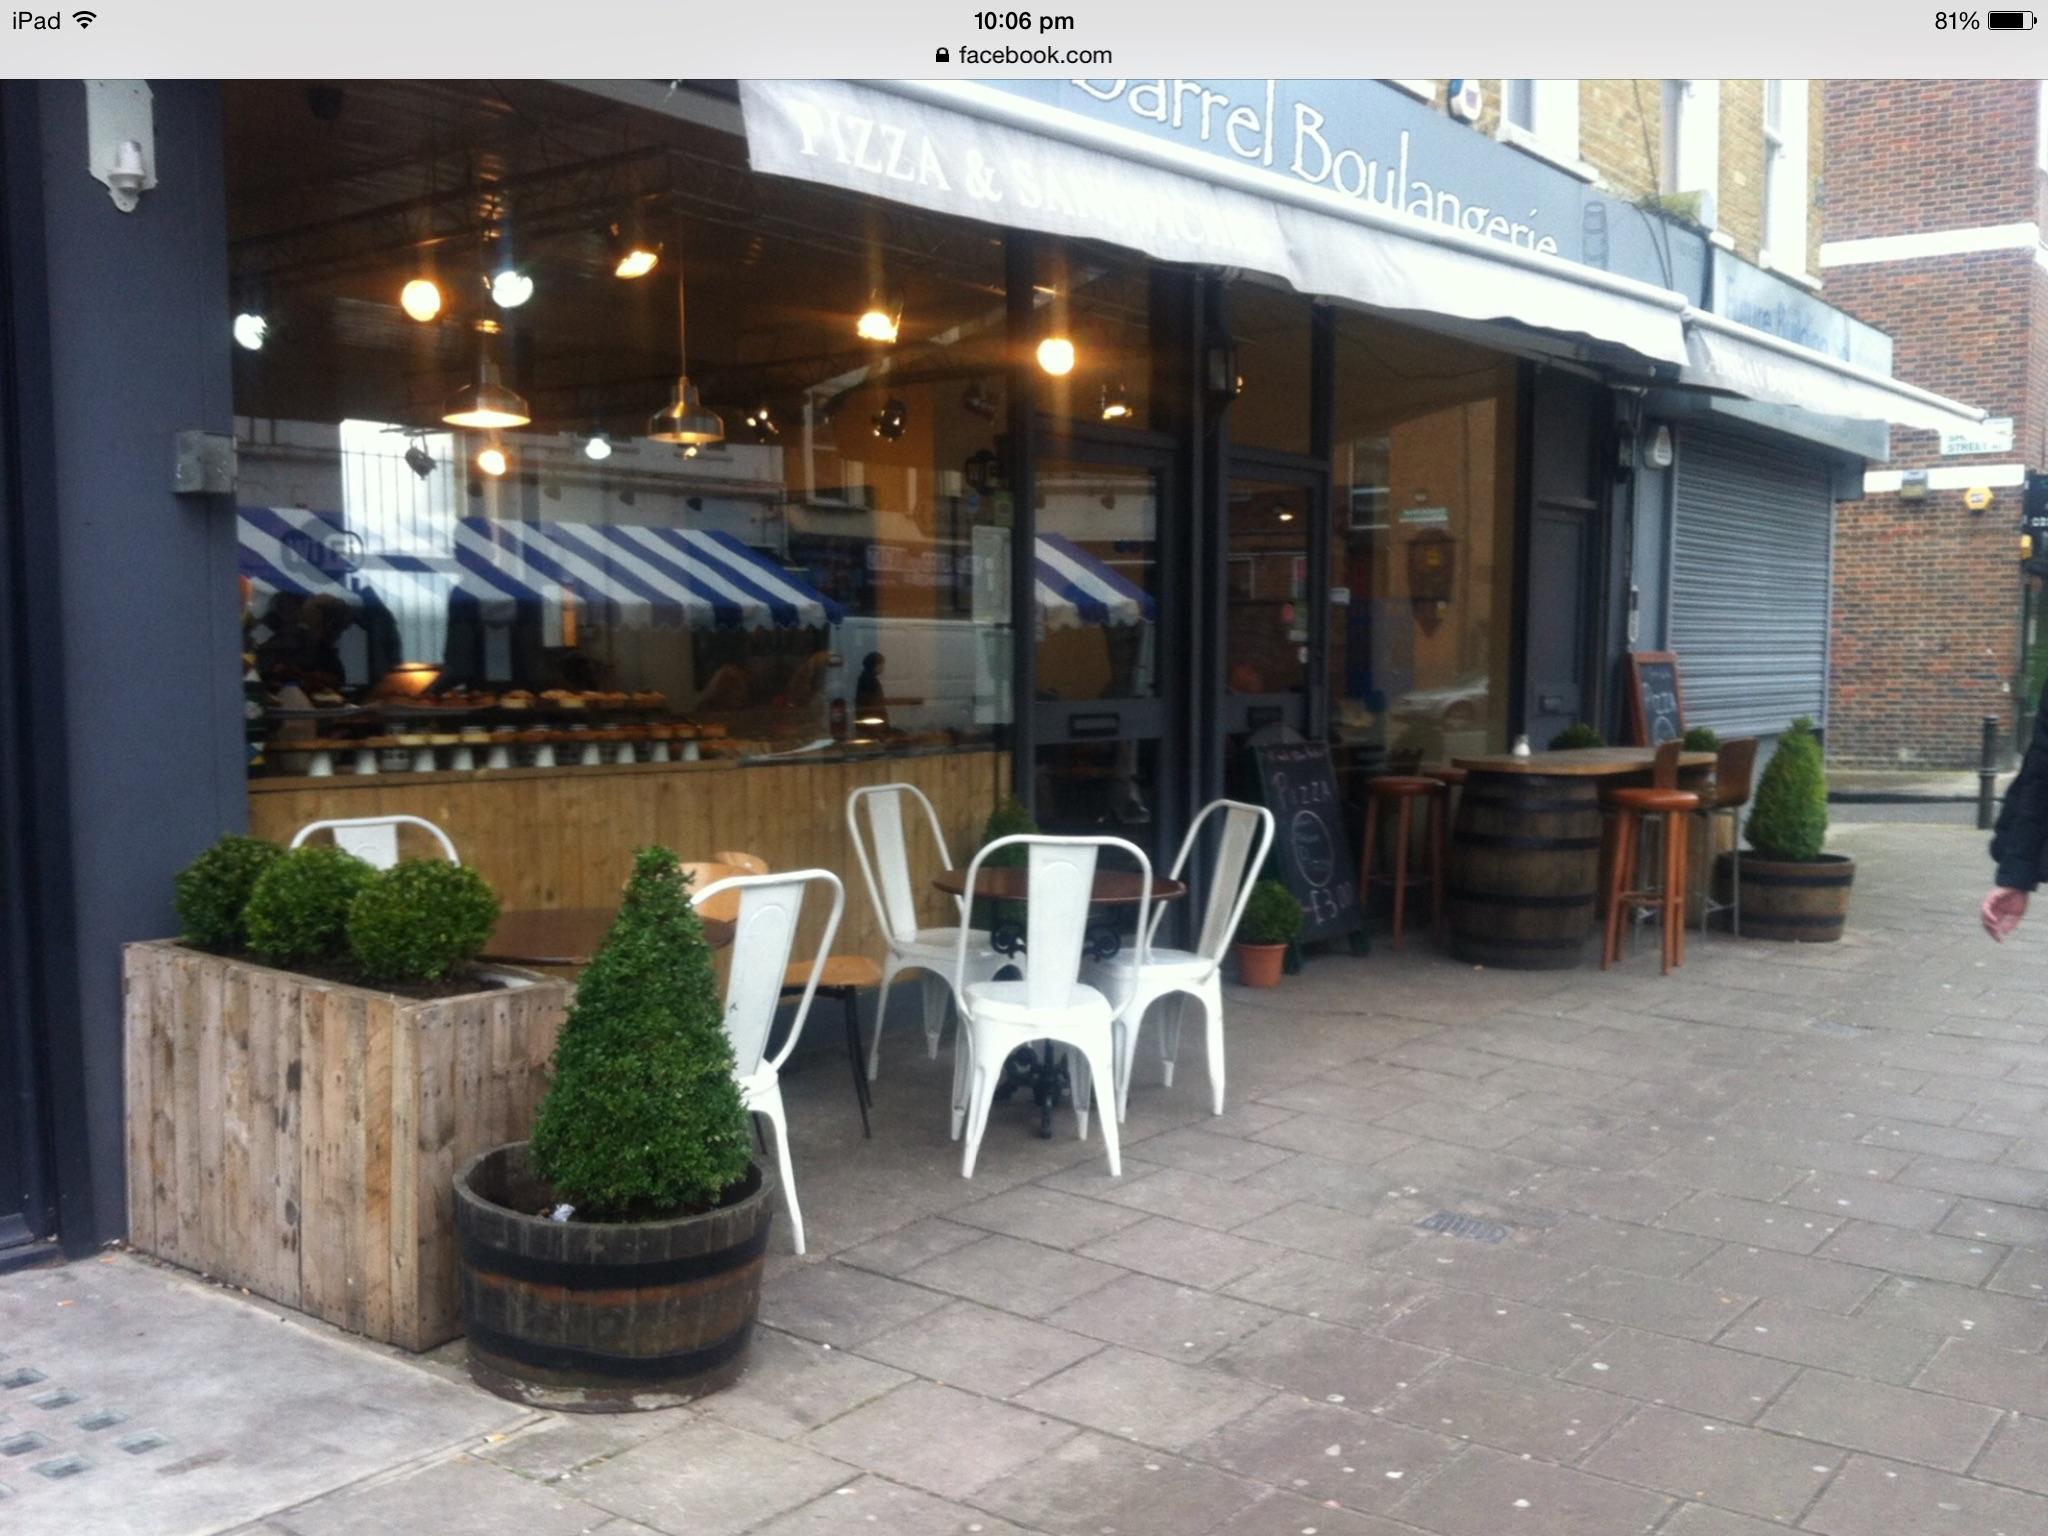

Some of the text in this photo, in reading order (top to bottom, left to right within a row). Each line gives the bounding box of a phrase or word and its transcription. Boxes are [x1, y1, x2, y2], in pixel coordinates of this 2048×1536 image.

[789, 100, 953, 191] PIZZA
[965, 149, 1002, 202] &
[1071, 79, 1275, 167] arrel
